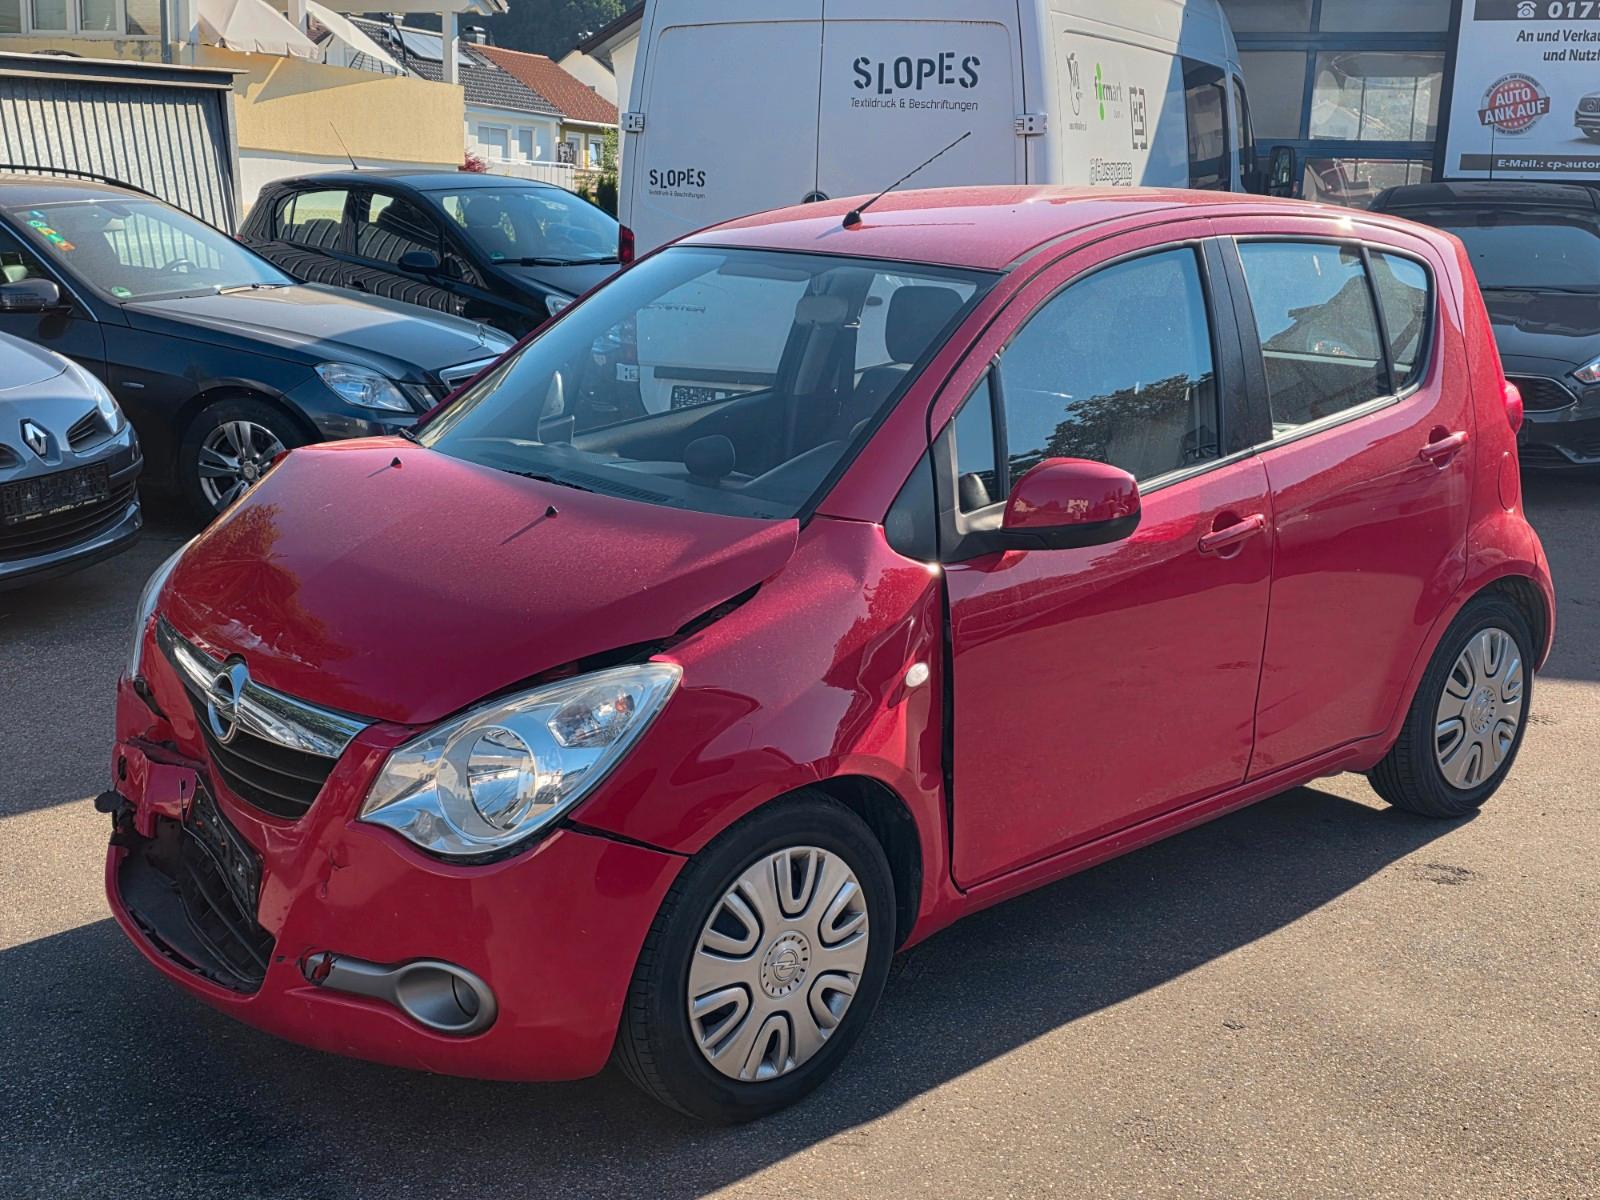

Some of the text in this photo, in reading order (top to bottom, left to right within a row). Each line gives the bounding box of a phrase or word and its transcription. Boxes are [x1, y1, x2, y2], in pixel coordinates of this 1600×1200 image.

[1548, 1, 1600, 18] 017
[1516, 29, 1534, 42] An
[1537, 29, 1560, 42] und
[1543, 49, 1566, 61] und
[853, 52, 981, 94] SLOPES
[851, 97, 978, 112] Textildruck & Beschriftungen
[1495, 87, 1531, 107] AUTO
[1484, 99, 1545, 124] ANKAUF
[649, 168, 706, 189] SLOPES
